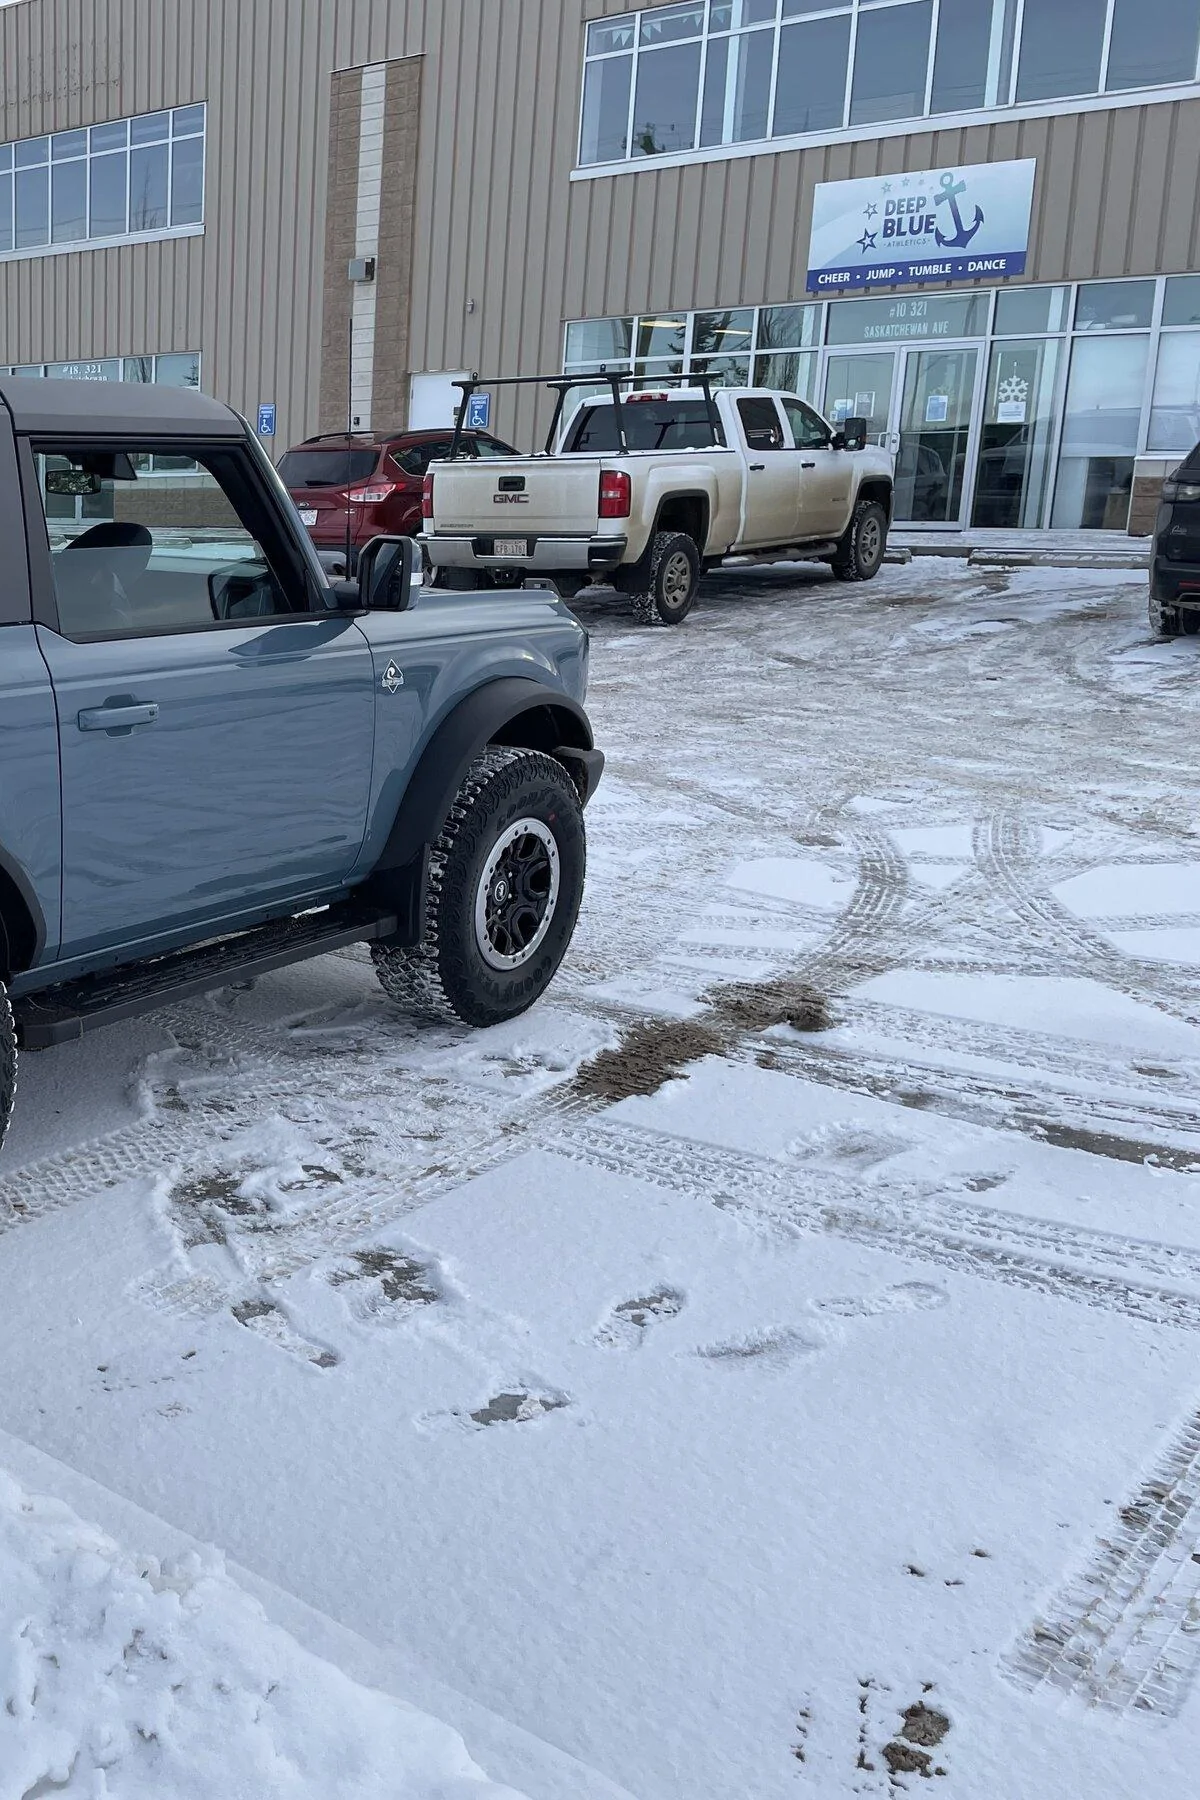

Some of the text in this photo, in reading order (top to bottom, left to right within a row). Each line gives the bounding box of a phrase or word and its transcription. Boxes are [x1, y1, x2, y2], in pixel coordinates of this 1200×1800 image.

[884, 196, 927, 217] DEEP
[882, 213, 937, 239] BLUE
[817, 258, 1006, 285] CHEER JUMP TUMBLE DANCE
[889, 301, 928, 318] #10 321
[863, 320, 949, 339] SASKATCHEWAN AVE
[84, 364, 102, 374] 321
[493, 494, 530, 504] GMC
